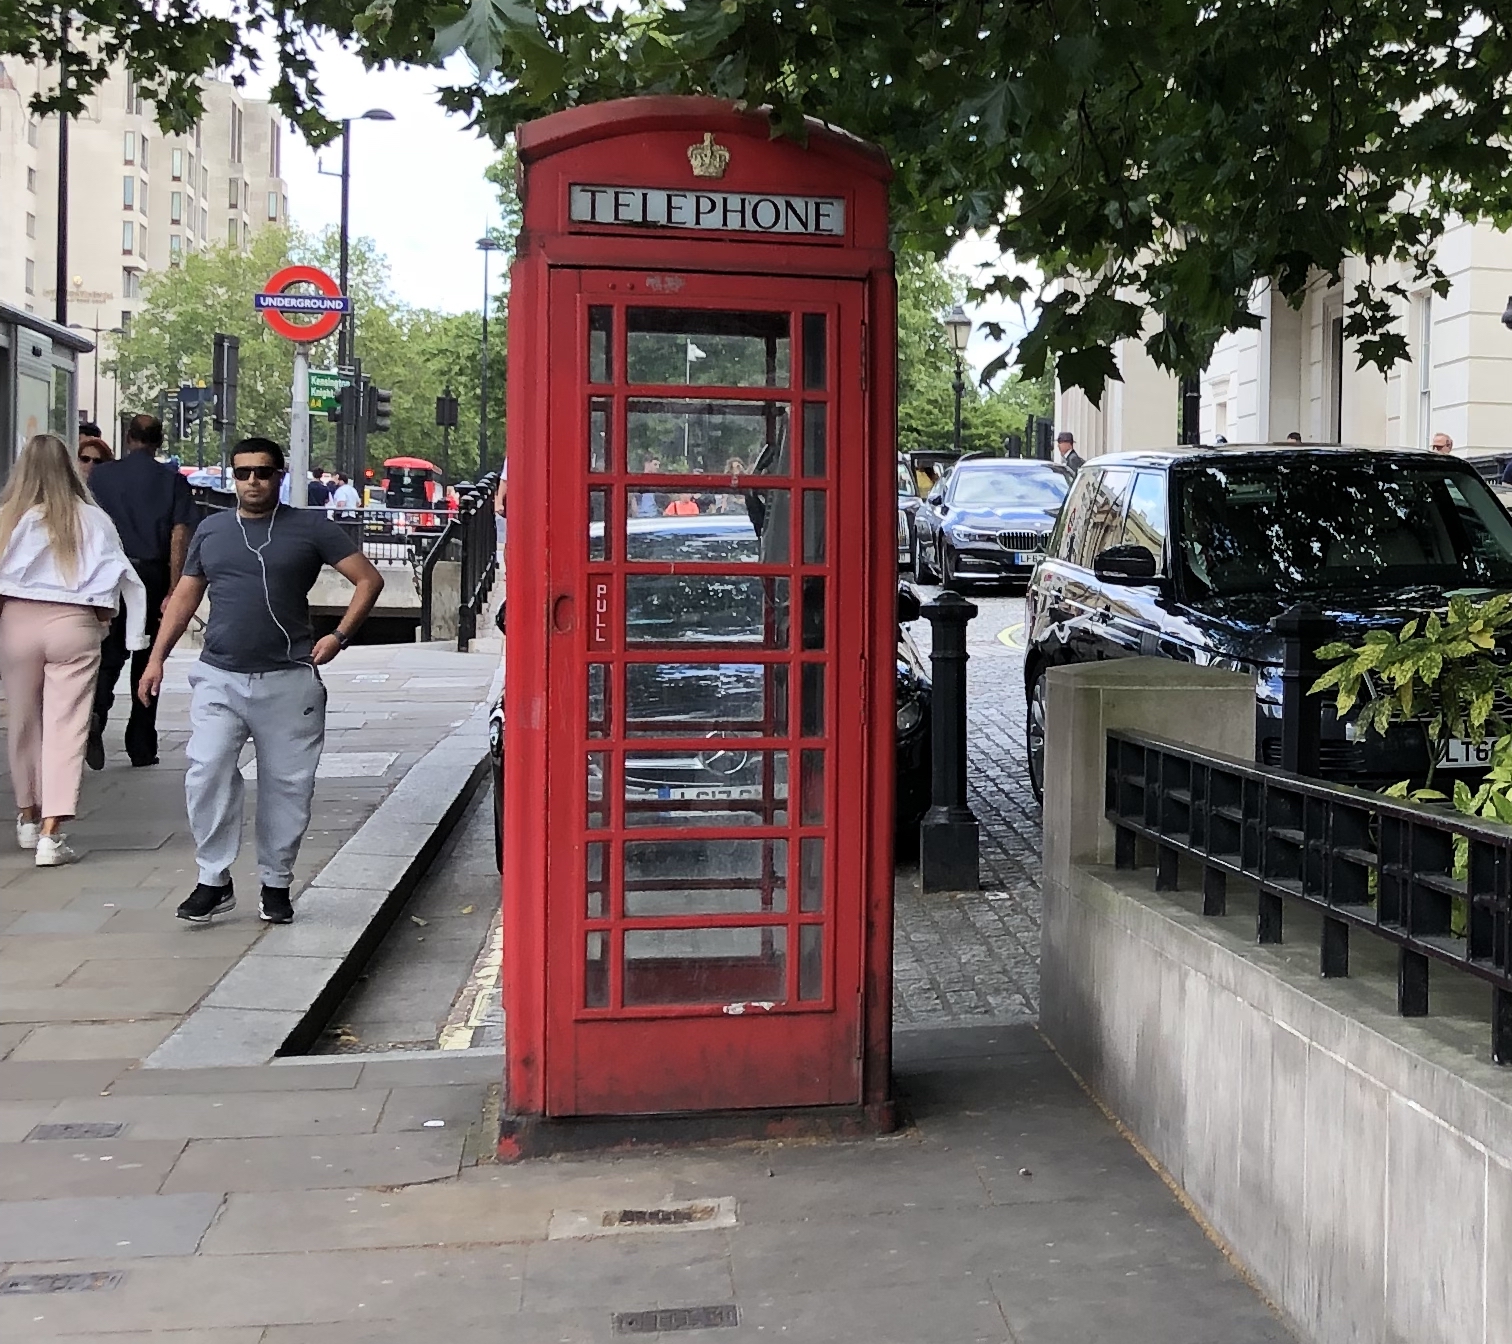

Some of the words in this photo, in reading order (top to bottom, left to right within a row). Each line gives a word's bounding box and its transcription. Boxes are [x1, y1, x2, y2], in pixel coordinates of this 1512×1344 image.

[579, 188, 835, 233] TELEPHONE
[260, 296, 344, 310] UNDERGROUND
[310, 386, 336, 400] Knight
[595, 584, 607, 642] PULL
[1445, 738, 1499, 763] LT6
